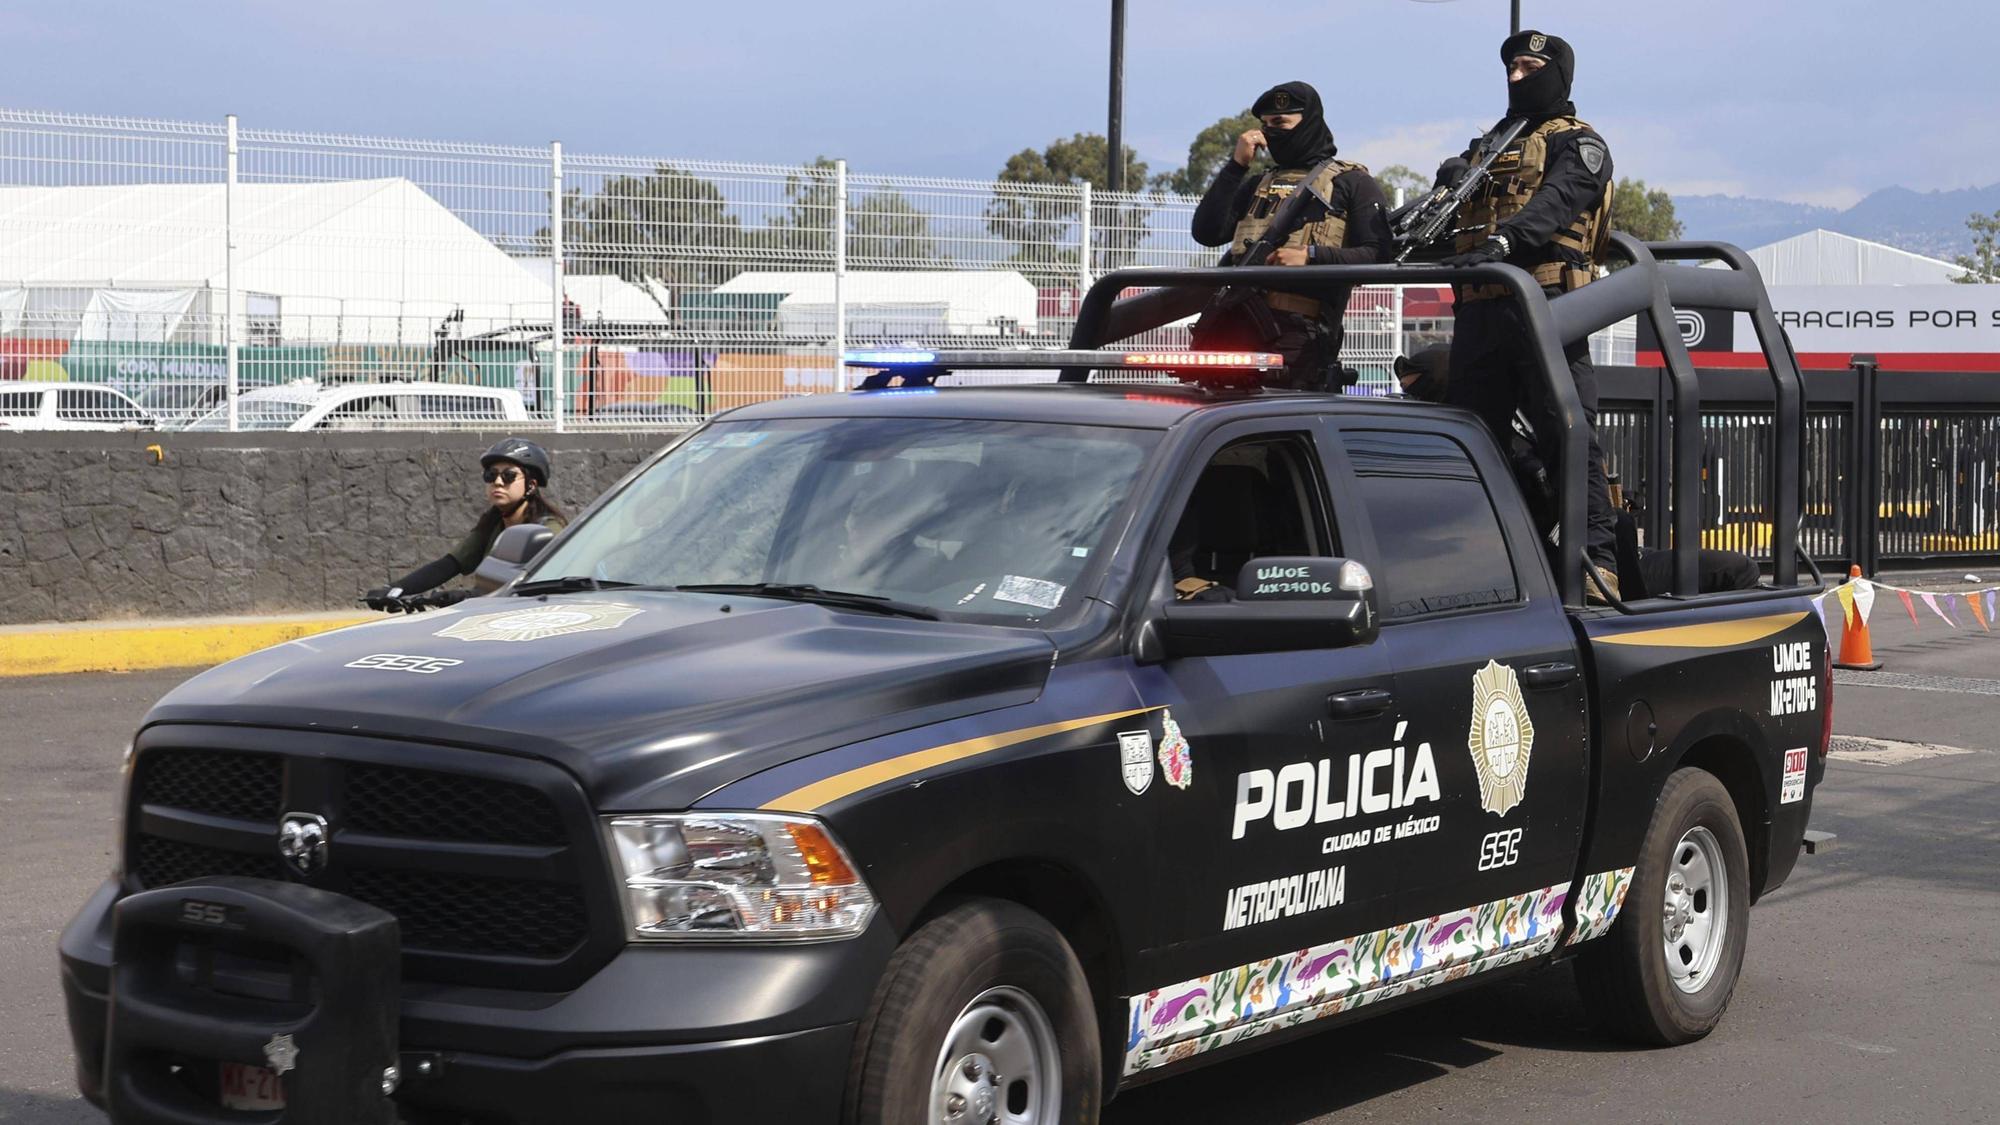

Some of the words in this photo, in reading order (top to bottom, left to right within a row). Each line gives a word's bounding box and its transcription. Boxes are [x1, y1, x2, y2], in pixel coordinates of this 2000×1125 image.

[1774, 310, 1895, 328] RACIAS
[1908, 310, 1976, 328] POR
[118, 360, 159, 375] COPA
[162, 362, 228, 379] MUNDIAL
[1773, 641, 1812, 673] UMOE
[1785, 751, 1806, 774] 911
[1232, 721, 1441, 840] POLICÍA
[1321, 828, 1371, 854] CIUDAD
[1373, 825, 1392, 844] DE
[1394, 814, 1441, 840] MÉXICO
[1222, 864, 1346, 932] METROPOLITANA
